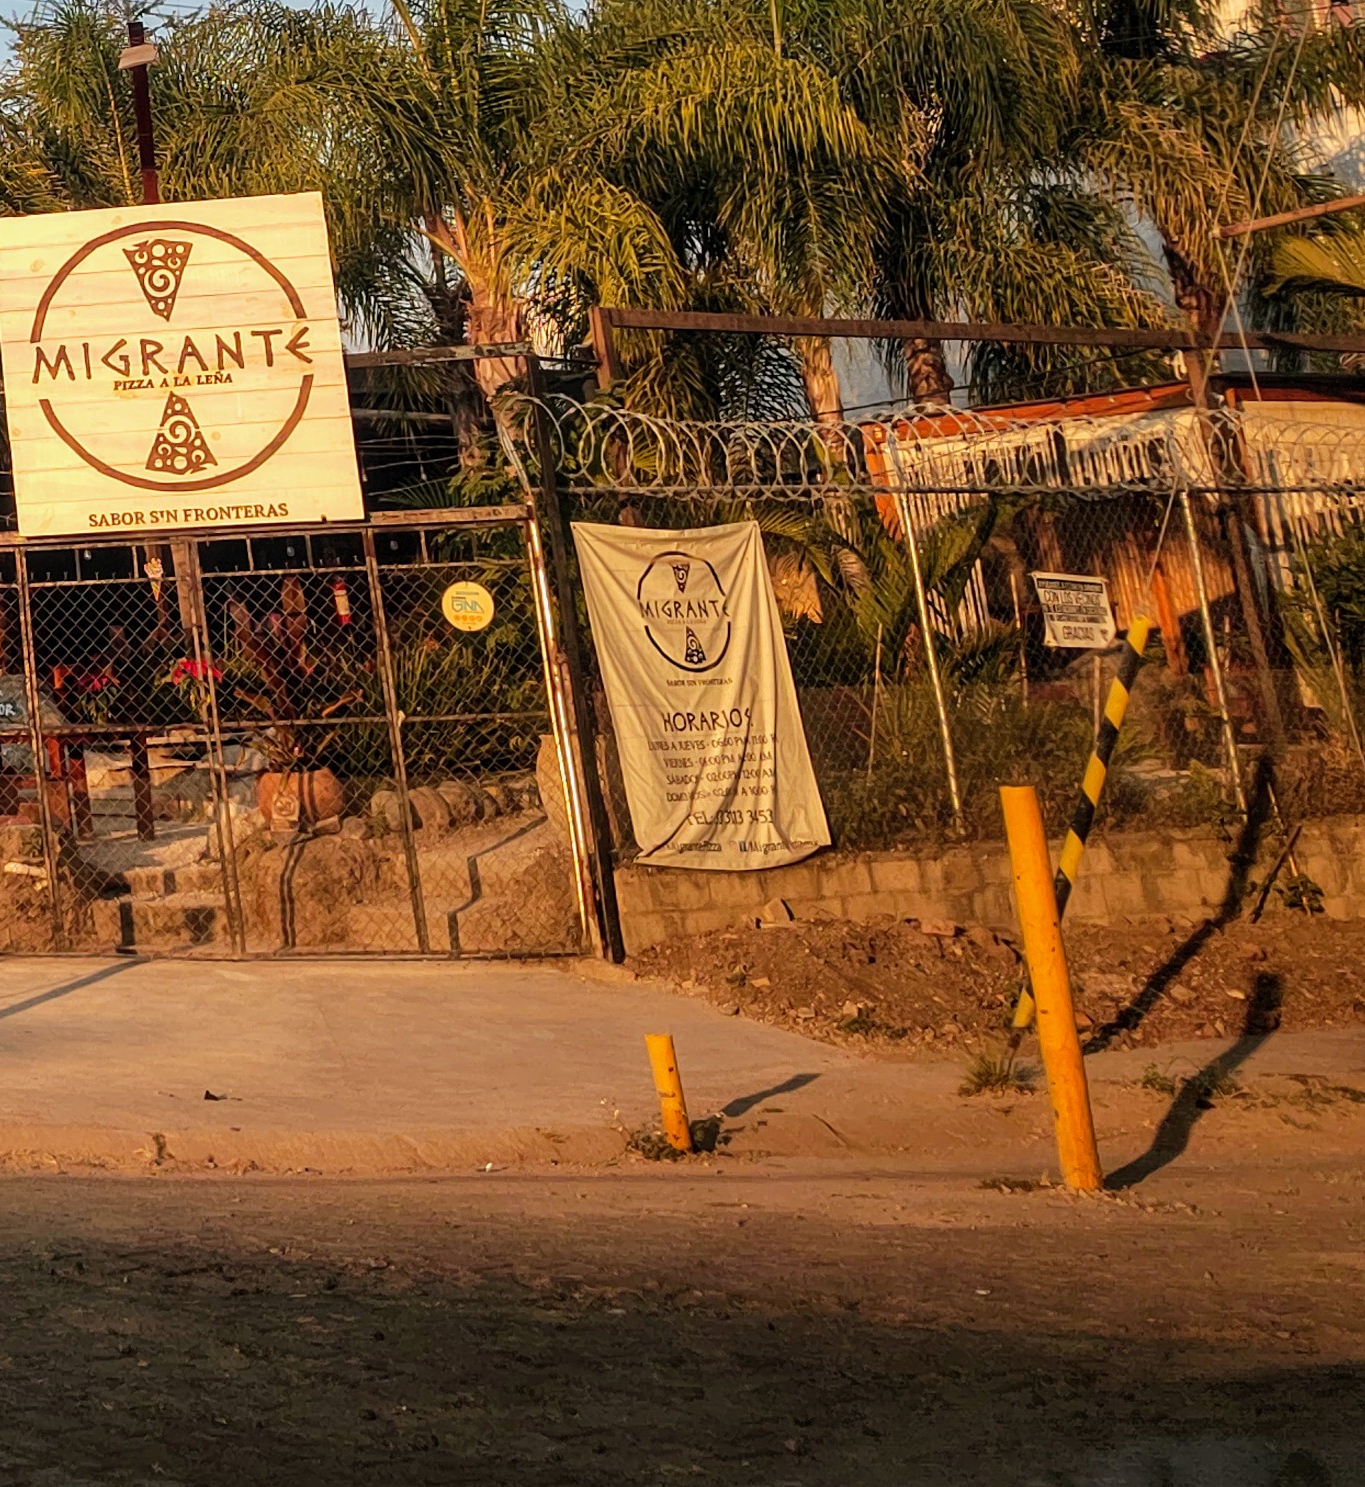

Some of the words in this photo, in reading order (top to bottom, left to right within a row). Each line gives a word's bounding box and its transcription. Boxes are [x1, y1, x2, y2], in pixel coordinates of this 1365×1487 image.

[32, 326, 313, 384] MIGRANTE
[113, 379, 154, 391] PIZZA
[160, 377, 169, 387] A
[173, 375, 192, 387] LA
[197, 371, 233, 385] LEÑA
[88, 511, 146, 527] SABOR
[183, 502, 289, 522] FRONTERAS
[639, 600, 730, 619] MIGRANTE
